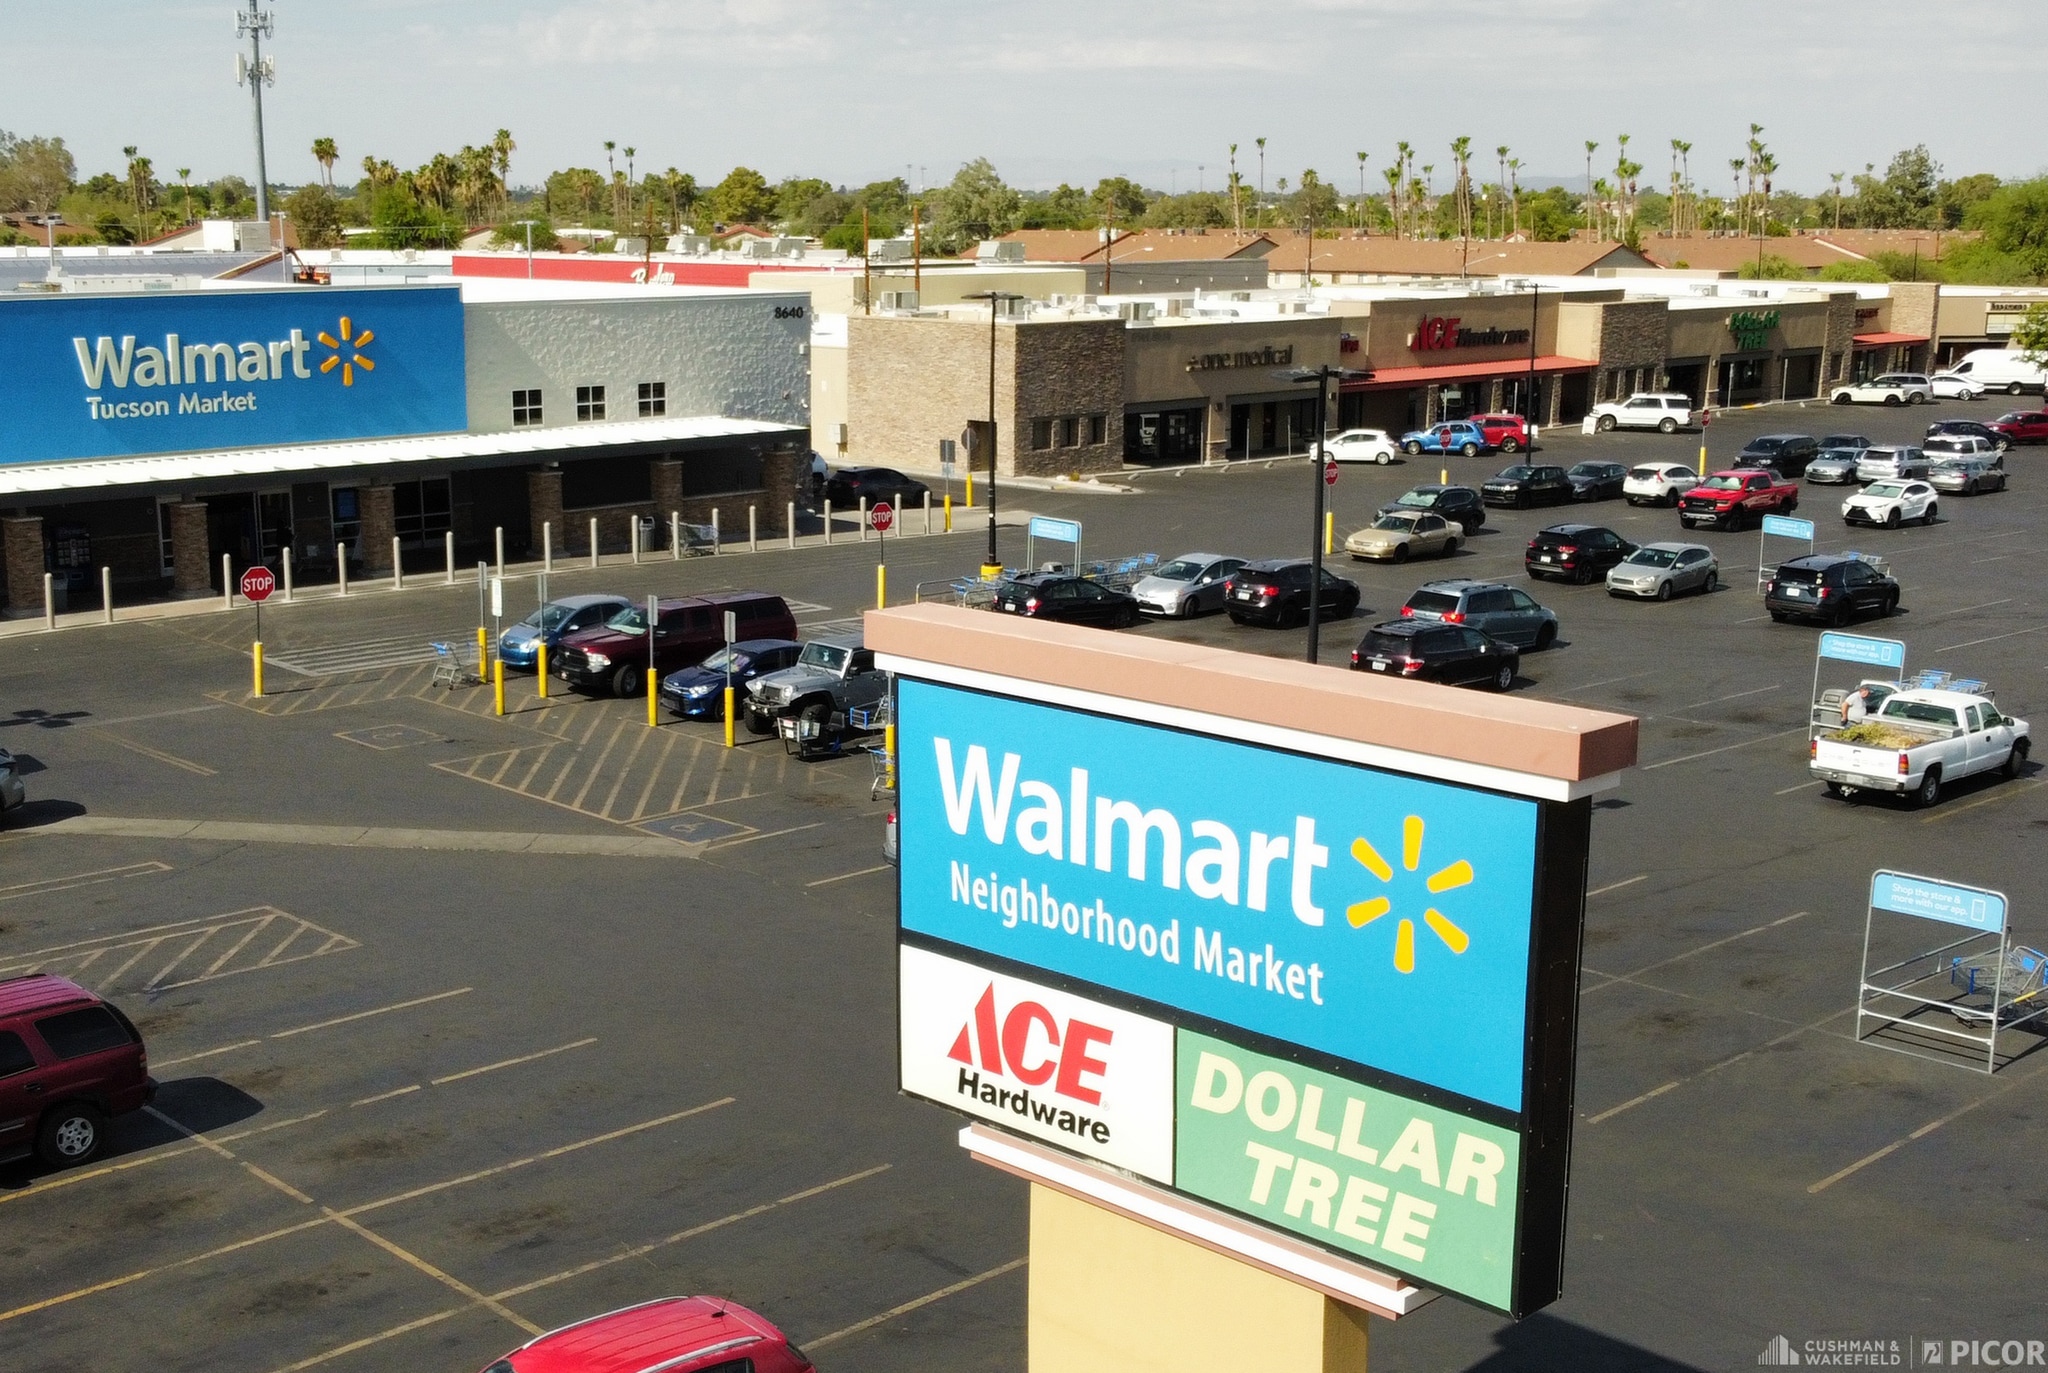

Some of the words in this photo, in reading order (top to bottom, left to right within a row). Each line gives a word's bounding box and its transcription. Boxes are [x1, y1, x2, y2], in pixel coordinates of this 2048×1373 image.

[774, 306, 804, 319] 8640
[1729, 310, 1781, 331] DOLLAR
[1410, 314, 1461, 352] ACE
[1458, 326, 1530, 347] Hardware
[1737, 331, 1769, 350] TREE
[72, 329, 311, 390] Walmart
[86, 396, 169, 420] Tucson
[178, 391, 257, 414] Market
[872, 511, 891, 524] STOP
[243, 577, 272, 592] STOP
[934, 736, 1329, 927] Walmart
[1891, 894, 1914, 904] more
[1915, 898, 1934, 909] with
[1935, 902, 1950, 912] our
[1950, 906, 1967, 916] app.
[1892, 883, 1914, 895] Shop
[1915, 887, 1930, 899] the
[1931, 891, 1953, 903] store
[1953, 896, 1961, 904] &
[951, 860, 1180, 965] Neighborhood
[1194, 926, 1324, 1006] Market
[947, 980, 1114, 1107] ACE
[957, 1067, 1111, 1145] Hardware
[1190, 1050, 1506, 1207] DOLLAR
[1244, 1141, 1437, 1263] TREE
